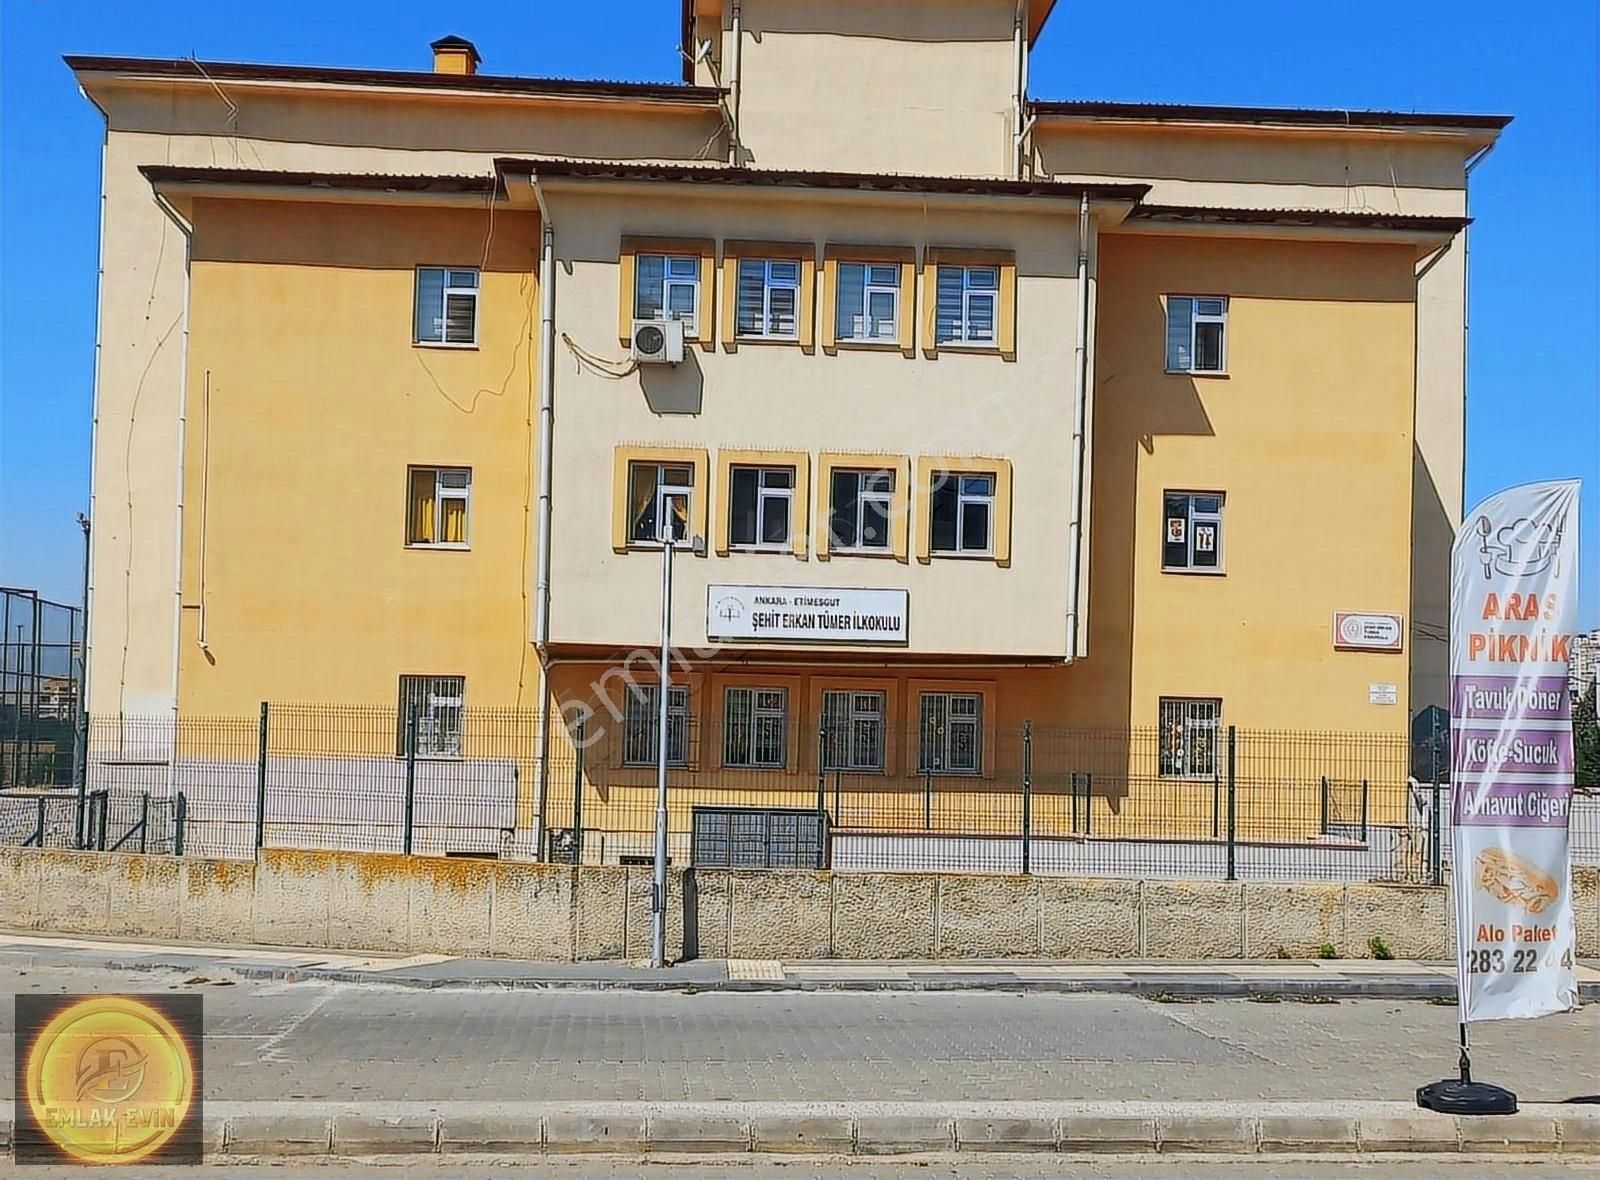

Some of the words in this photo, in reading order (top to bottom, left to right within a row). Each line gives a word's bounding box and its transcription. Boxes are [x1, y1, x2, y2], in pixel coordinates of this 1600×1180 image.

[753, 596, 787, 606] ANKARA
[1482, 592, 1557, 620] ARAS
[752, 609, 781, 632] ŞEHİT
[783, 612, 815, 629] ERKAN
[818, 610, 851, 631] TÜMER
[853, 610, 900, 631] İLKOKULU
[1468, 627, 1570, 662] PİKNİK
[1465, 685, 1511, 710] Tavuk
[1518, 685, 1562, 711] Döner
[1463, 790, 1524, 816] Anavut
[1477, 924, 1505, 942] Alo
[1511, 924, 1558, 942] Paket
[1466, 949, 1505, 973] 283
[1513, 949, 1538, 972] 22
